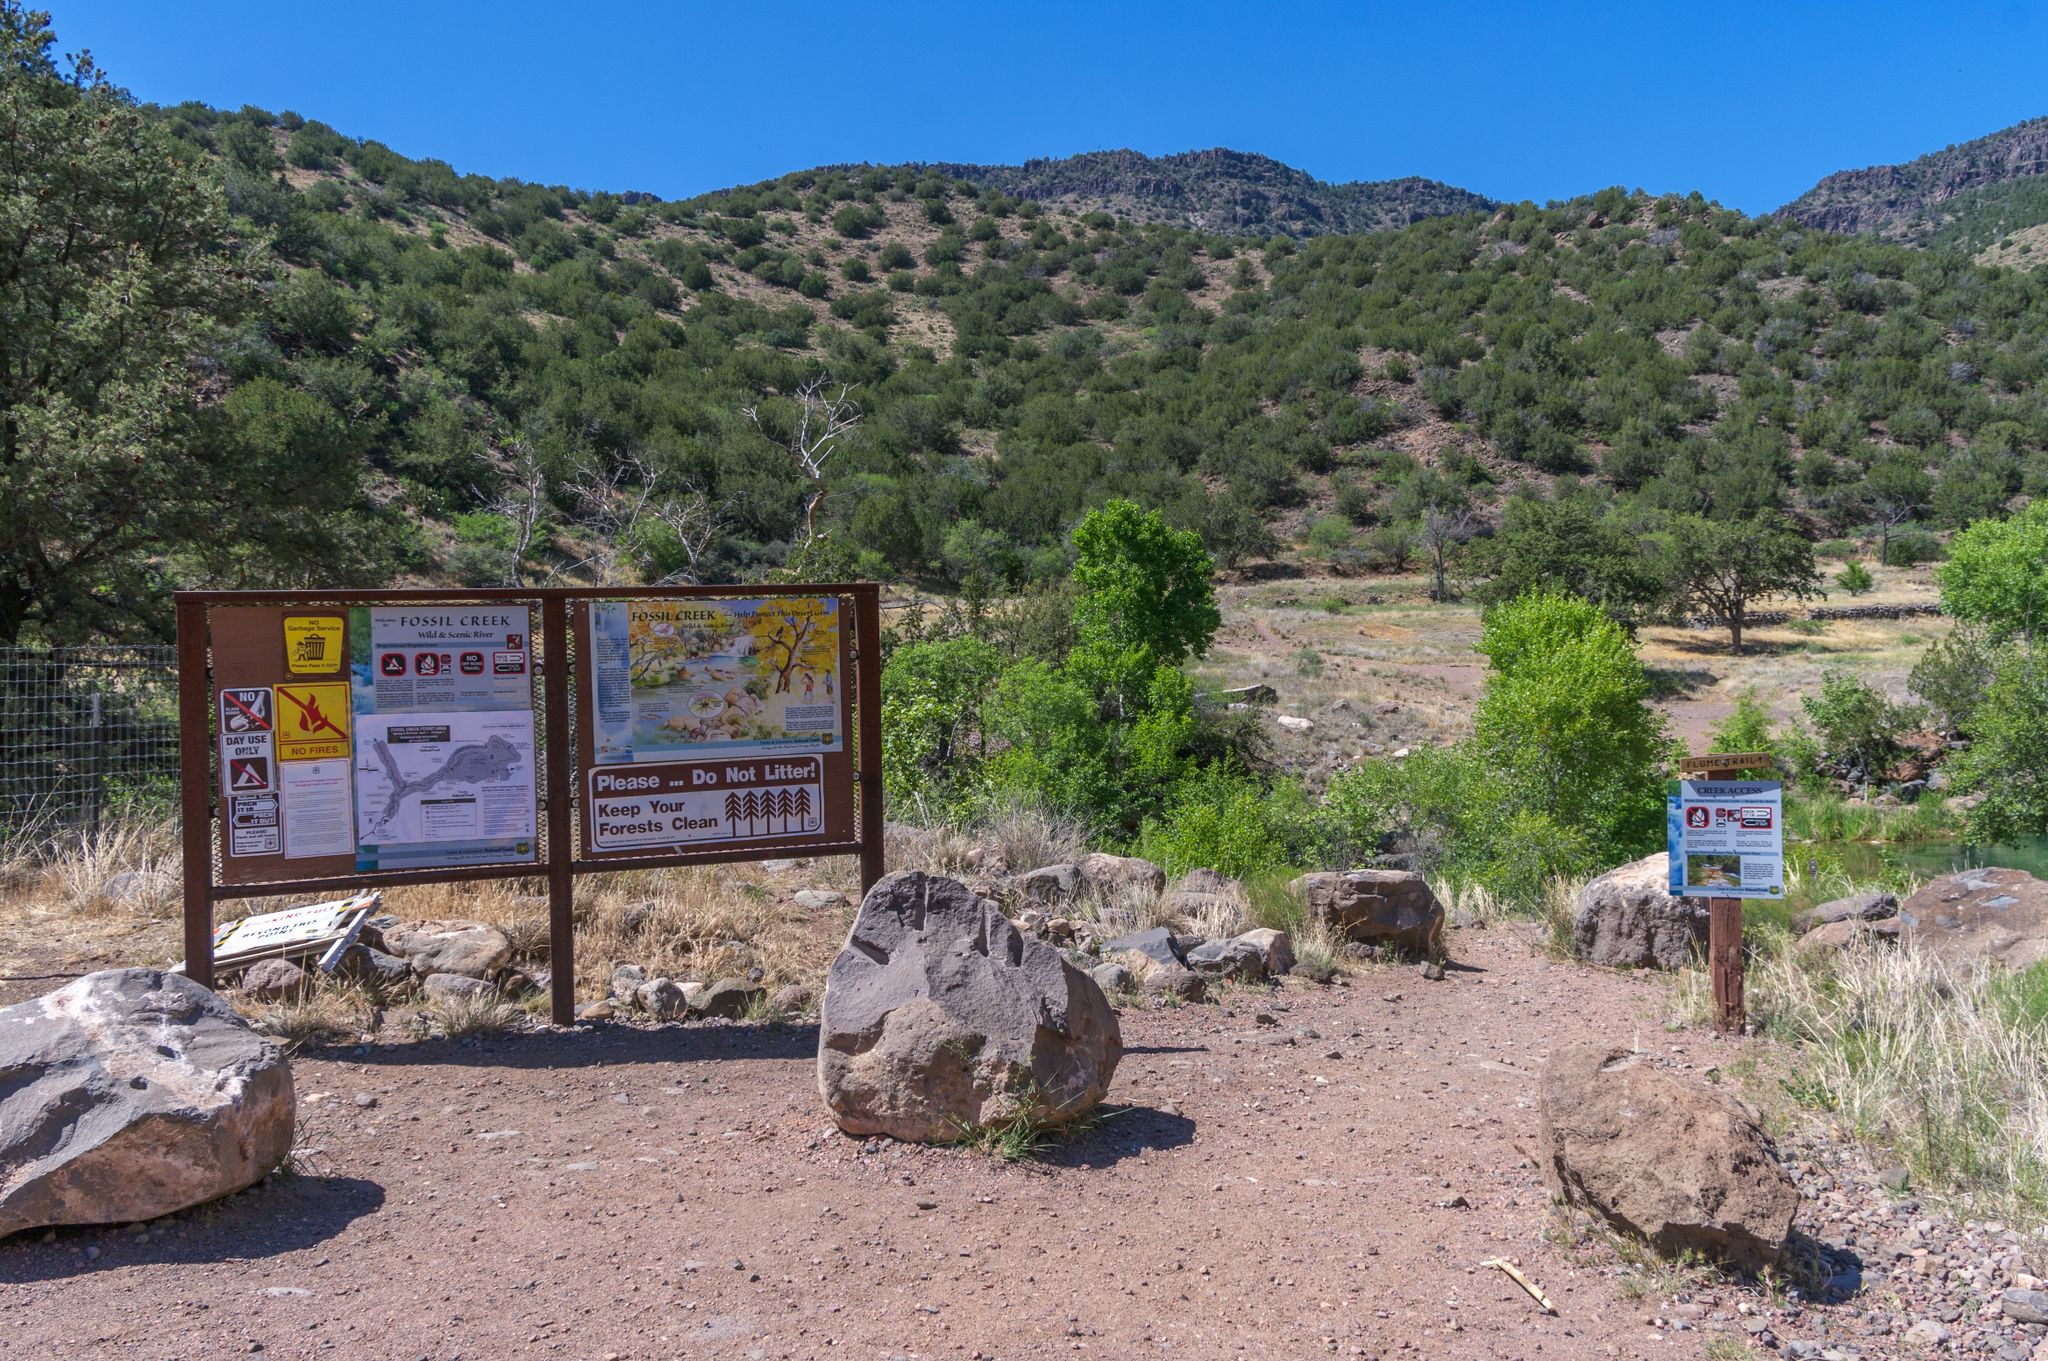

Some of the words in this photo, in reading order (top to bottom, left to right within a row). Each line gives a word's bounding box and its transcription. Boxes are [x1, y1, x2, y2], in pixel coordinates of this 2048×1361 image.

[400, 616, 454, 627] FOSSIL
[460, 615, 511, 626] CREEK
[632, 611, 671, 622] FOSSIL
[675, 610, 716, 621] CREEK
[734, 611, 750, 619] Help
[418, 630, 437, 639] Wild
[448, 630, 473, 638] Scenic
[474, 630, 495, 638] River
[239, 692, 256, 702] NO
[226, 736, 245, 746] DAY
[248, 734, 267, 744] USE
[235, 746, 260, 756] ONLY
[291, 747, 307, 756] NO
[309, 745, 339, 755] FIRES
[1687, 759, 1720, 768] FLUME
[1726, 757, 1755, 767] TRAIL
[597, 773, 660, 792] Please
[692, 769, 717, 785] Do
[726, 765, 756, 783] Not
[764, 762, 816, 780] Litter!
[1697, 787, 1726, 795] CREEK
[598, 802, 641, 819] Keep
[649, 800, 685, 814] Your
[599, 818, 663, 837] Forests
[672, 815, 718, 831] Clean
[245, 911, 302, 928] PKING
[242, 925, 290, 938] BEYOND
[293, 919, 317, 928] THIS
[258, 928, 293, 939] POINT
